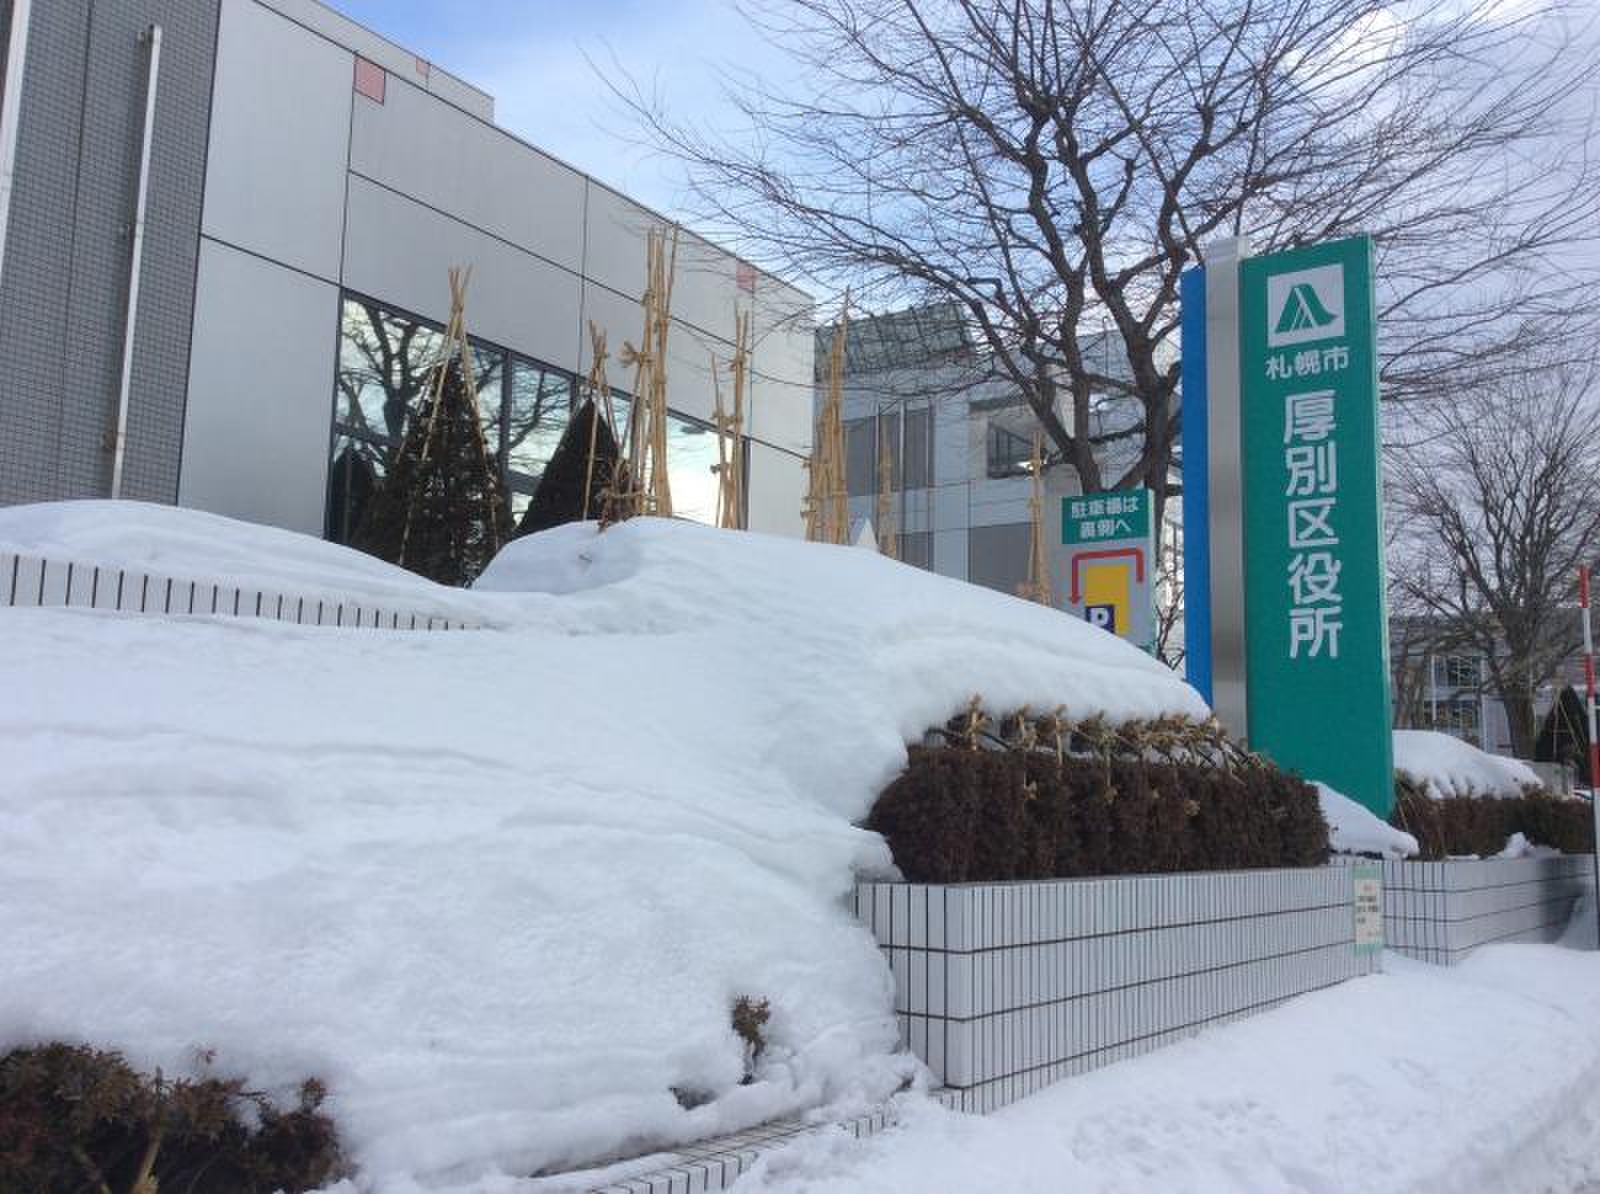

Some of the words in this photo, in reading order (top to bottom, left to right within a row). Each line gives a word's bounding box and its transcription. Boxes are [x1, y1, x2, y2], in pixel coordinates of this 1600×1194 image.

[1266, 346, 1350, 379] 札幌市
[1284, 389, 1343, 660] 厚別区役所
[1091, 608, 1109, 628] P
